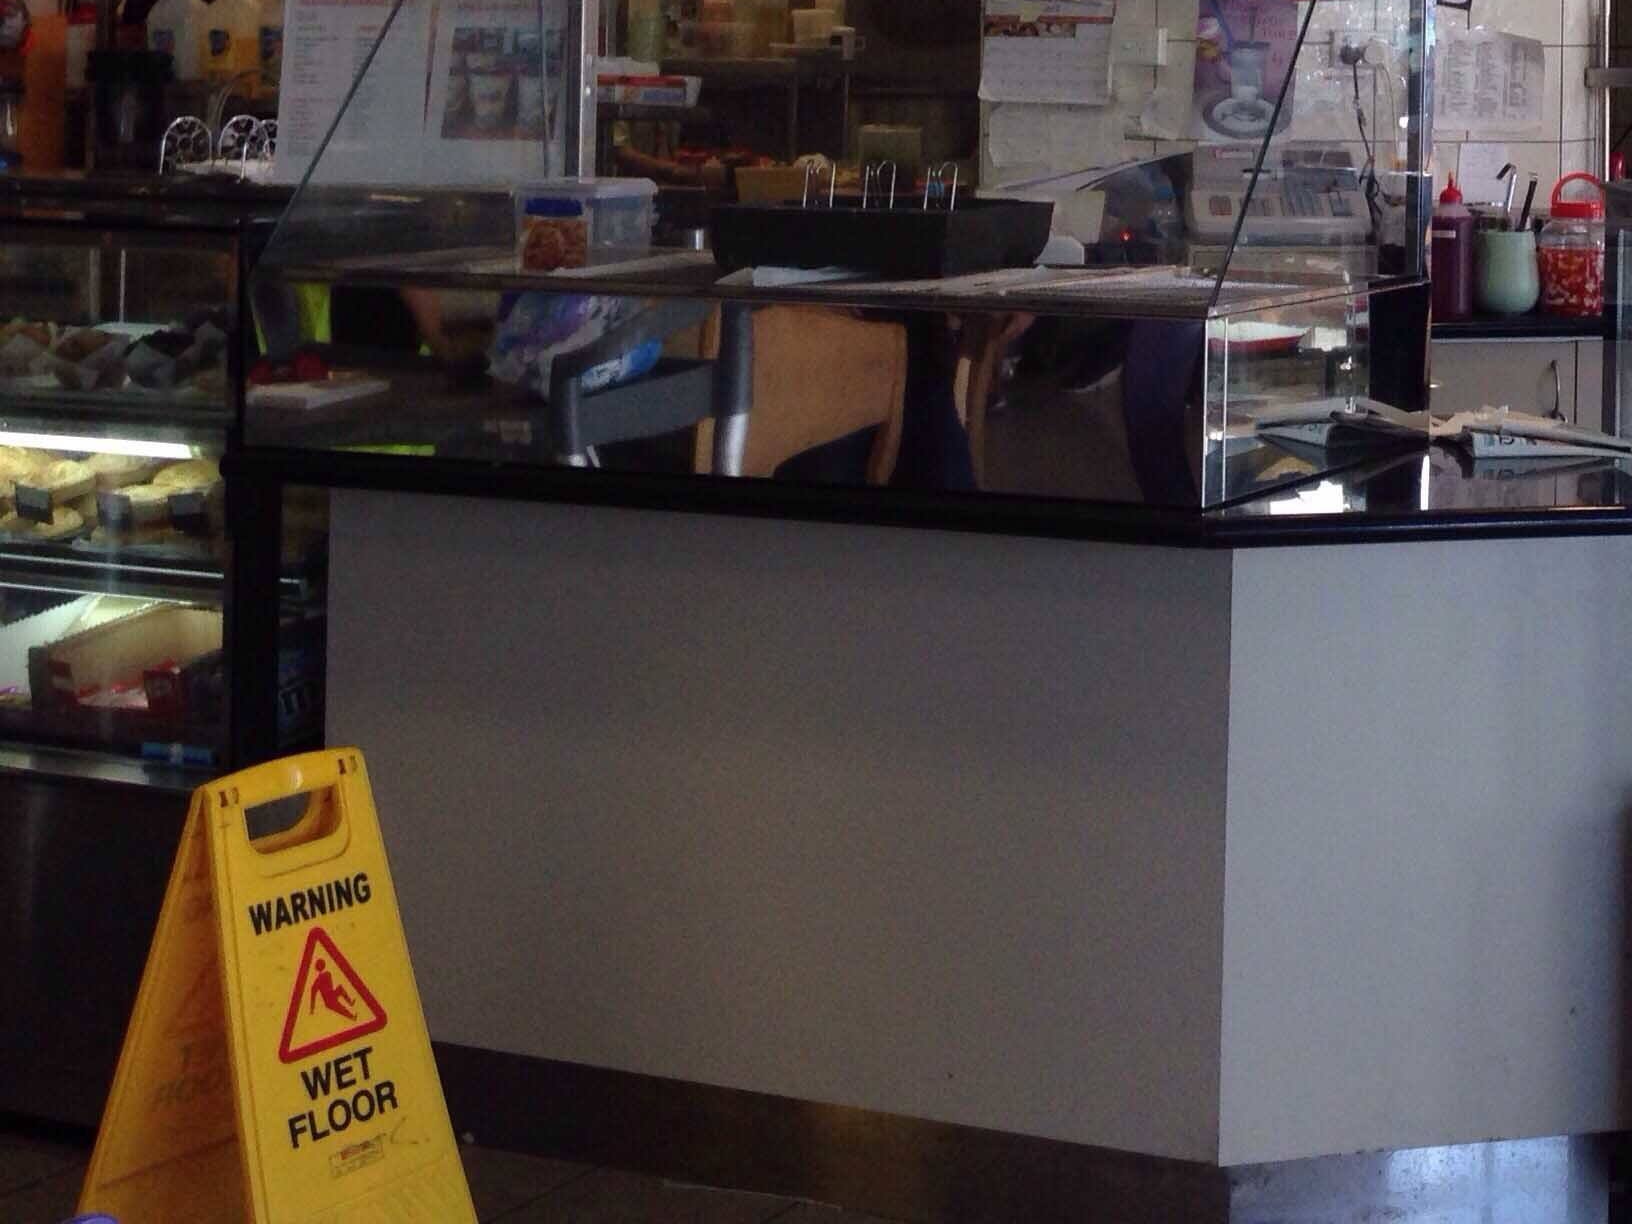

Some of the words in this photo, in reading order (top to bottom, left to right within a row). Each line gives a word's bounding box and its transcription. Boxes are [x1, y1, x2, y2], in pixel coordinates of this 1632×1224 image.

[247, 872, 373, 937] WARNING
[300, 1046, 375, 1101] WET
[287, 1079, 399, 1150] FLOOR
